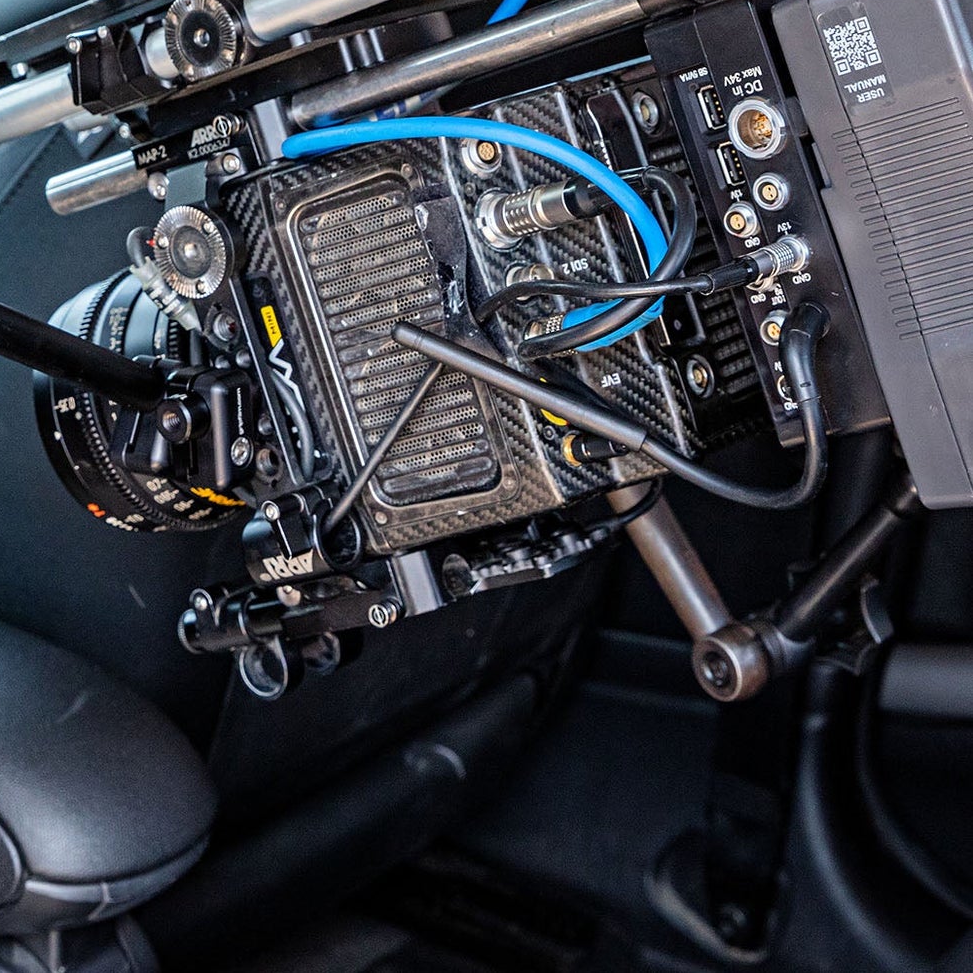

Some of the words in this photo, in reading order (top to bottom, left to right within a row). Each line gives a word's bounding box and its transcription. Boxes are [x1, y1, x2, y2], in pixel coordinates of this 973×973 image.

[698, 67, 709, 76] SB
[741, 66, 762, 79] Max
[724, 72, 742, 87] 34V
[844, 74, 887, 93] MANUAL
[732, 85, 744, 96] in
[744, 79, 763, 95] DC
[856, 87, 885, 102] USER
[138, 145, 167, 165] MAP-2
[730, 189, 743, 199] 13V
[777, 221, 792, 232] 13V
[744, 237, 760, 248] GND
[562, 263, 571, 275] 2
[570, 258, 589, 273] SDI
[792, 273, 811, 284] GND
[750, 293, 766, 304] GND
[601, 373, 621, 388] EVF
[260, 548, 314, 581] ARRI
